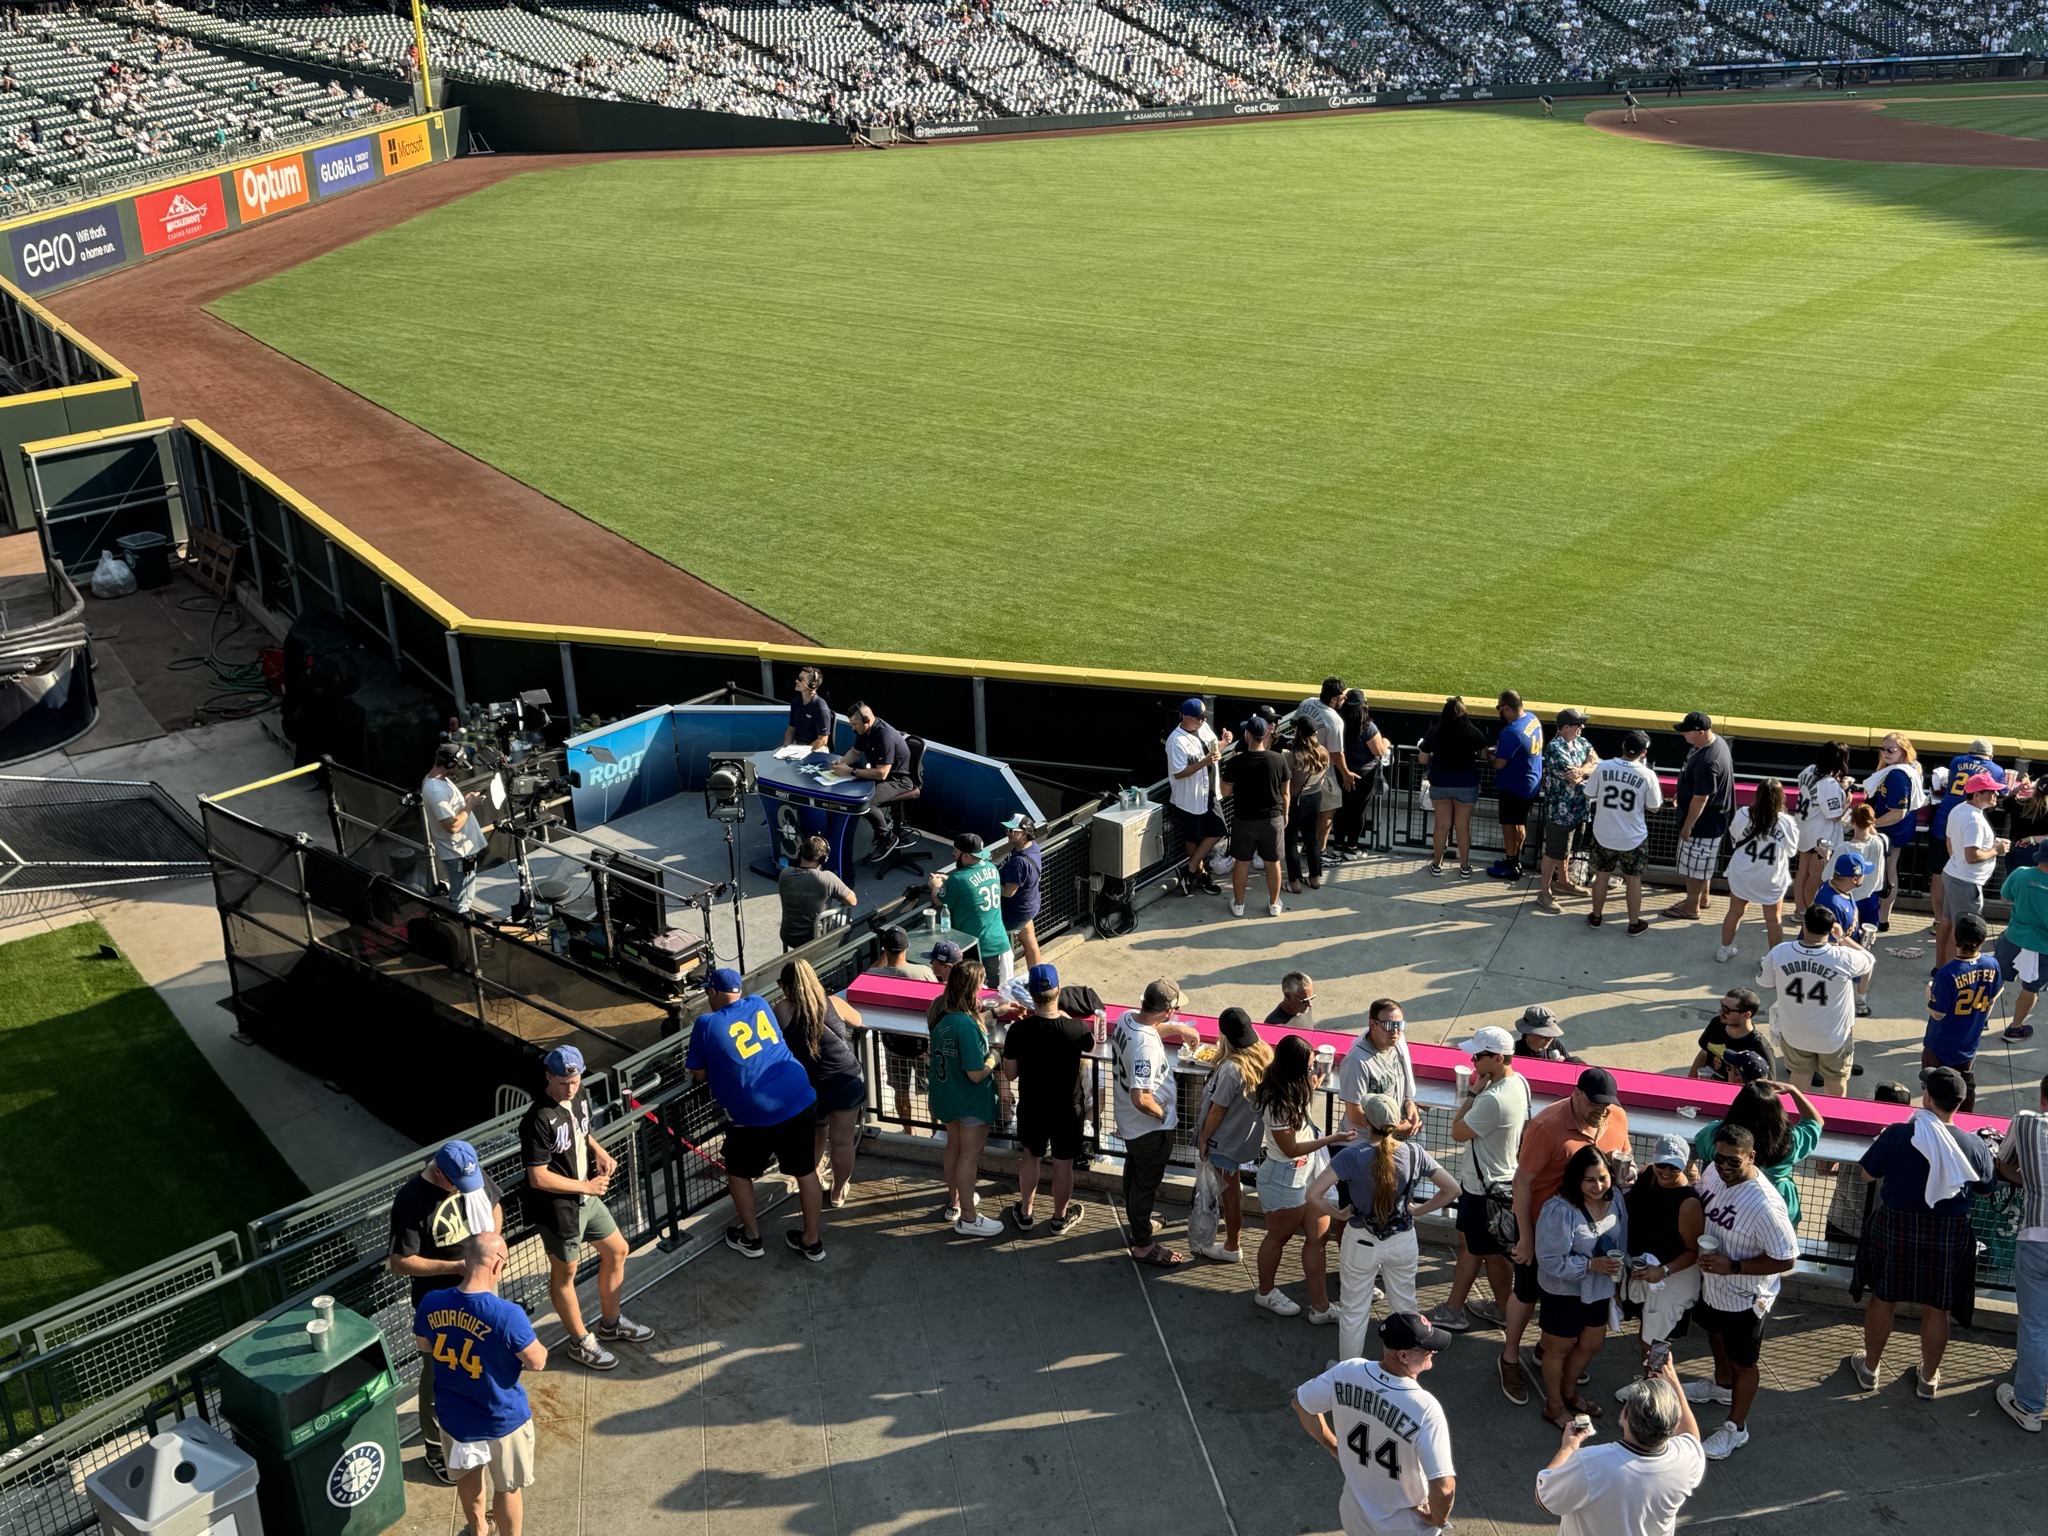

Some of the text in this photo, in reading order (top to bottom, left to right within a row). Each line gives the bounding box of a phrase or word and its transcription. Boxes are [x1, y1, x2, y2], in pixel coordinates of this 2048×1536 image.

[1234, 102, 1280, 114] Great Clips
[1341, 96, 1377, 105] LEXUS
[1132, 111, 1167, 120] CASAMIGOS
[355, 151, 369, 163] CREDIT
[397, 134, 425, 159] Microsoft
[320, 156, 357, 183] GLOBAL
[356, 161, 370, 173] UNION
[242, 164, 302, 215] Optum
[89, 224, 107, 240] that's
[165, 213, 201, 233] MUCKLESHOOT
[23, 232, 76, 278] eero
[80, 251, 87, 262] a
[85, 246, 104, 260] home
[589, 749, 645, 786] ROOT
[1602, 769, 1645, 790] RALEIGH
[1603, 785, 1637, 813] 29
[1744, 839, 1777, 866] 44
[978, 883, 1001, 912] 36
[1781, 958, 1839, 982] RODRÍGUEZ
[1954, 968, 1996, 990] GRIFFEY
[1784, 976, 1829, 1007] 44
[1954, 985, 1990, 1016] 24
[728, 1009, 780, 1060] 24
[427, 1306, 493, 1342] RODRÍGUEZ
[432, 1332, 483, 1380] 44
[1334, 1380, 1422, 1445] RODRÍGUEZ
[1346, 1420, 1402, 1481] 44
[333, 1447, 378, 1482] SEATTLE
[335, 1466, 380, 1502] MARINERS
